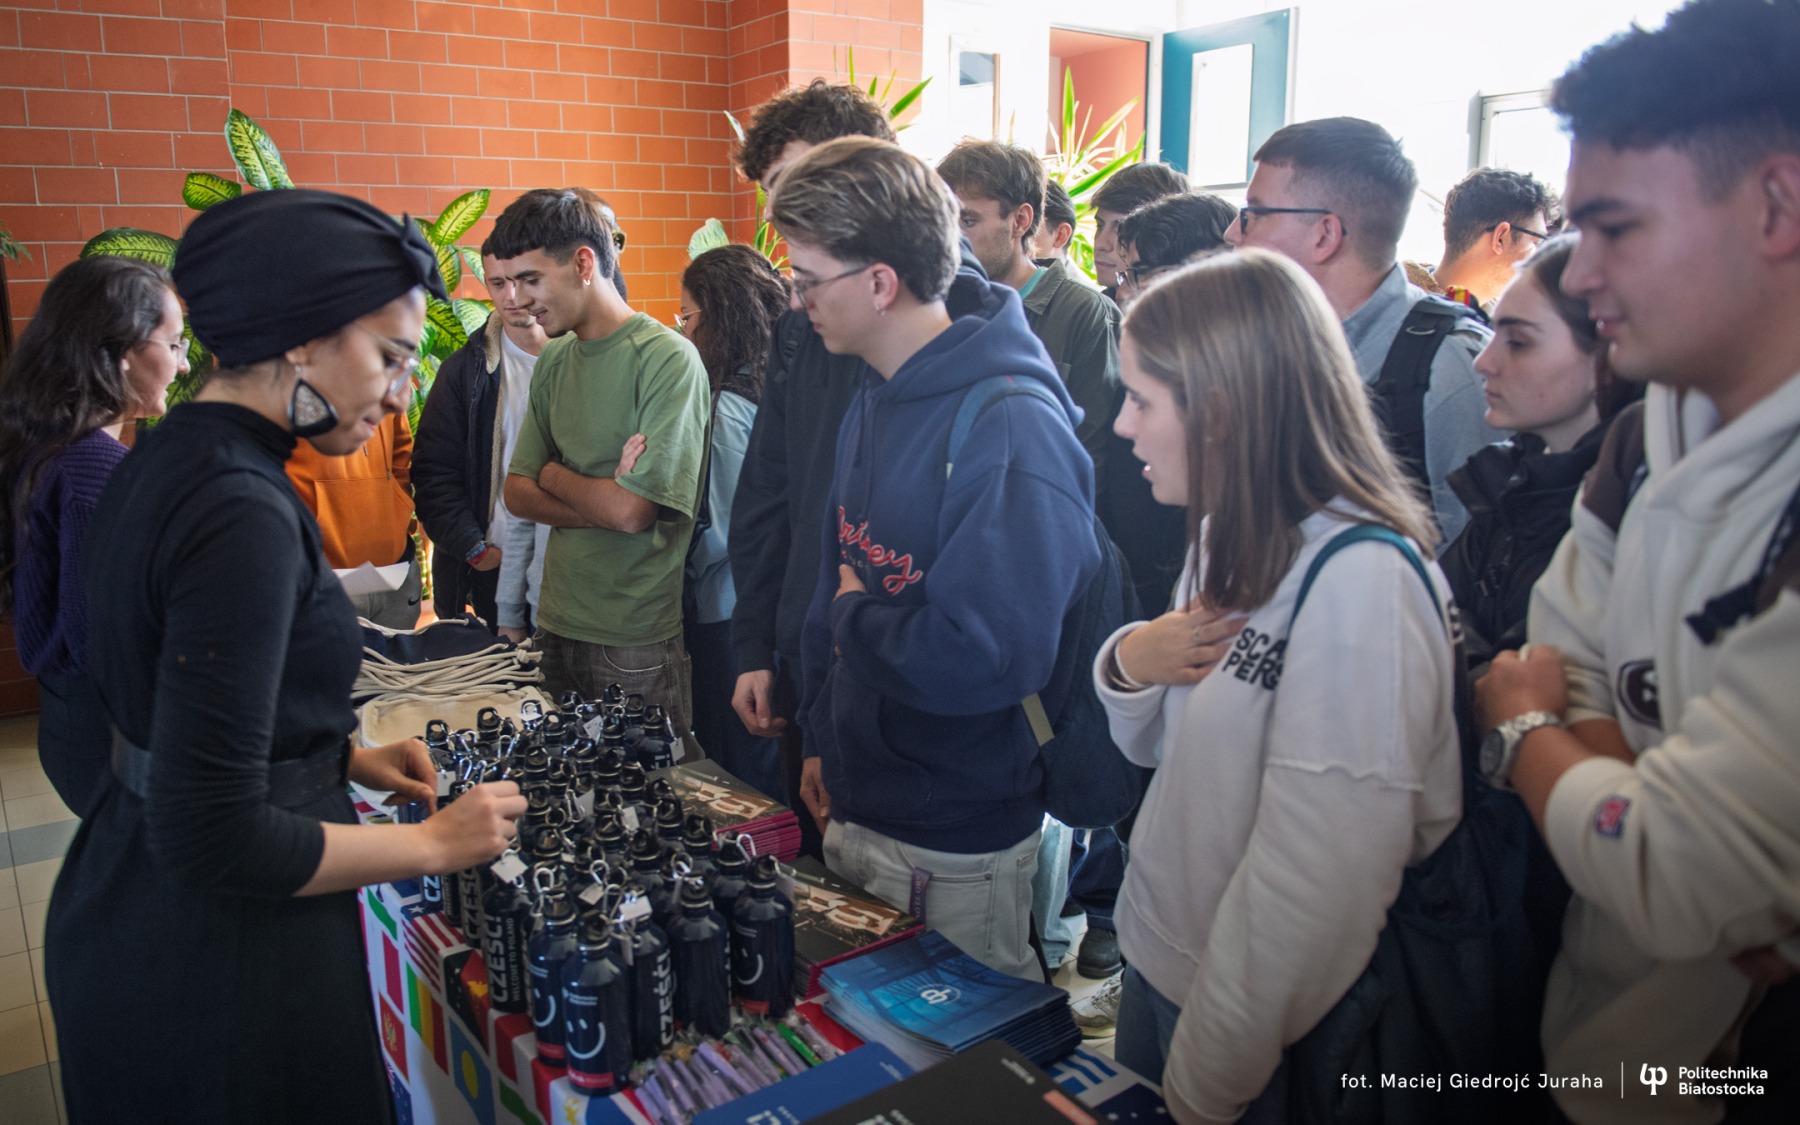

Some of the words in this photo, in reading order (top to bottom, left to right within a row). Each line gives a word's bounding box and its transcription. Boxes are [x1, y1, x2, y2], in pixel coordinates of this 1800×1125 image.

[1236, 627, 1287, 660] SCA
[506, 917, 518, 950] POLAND
[508, 951, 518, 962] TO
[509, 964, 521, 1002] WELCOME
